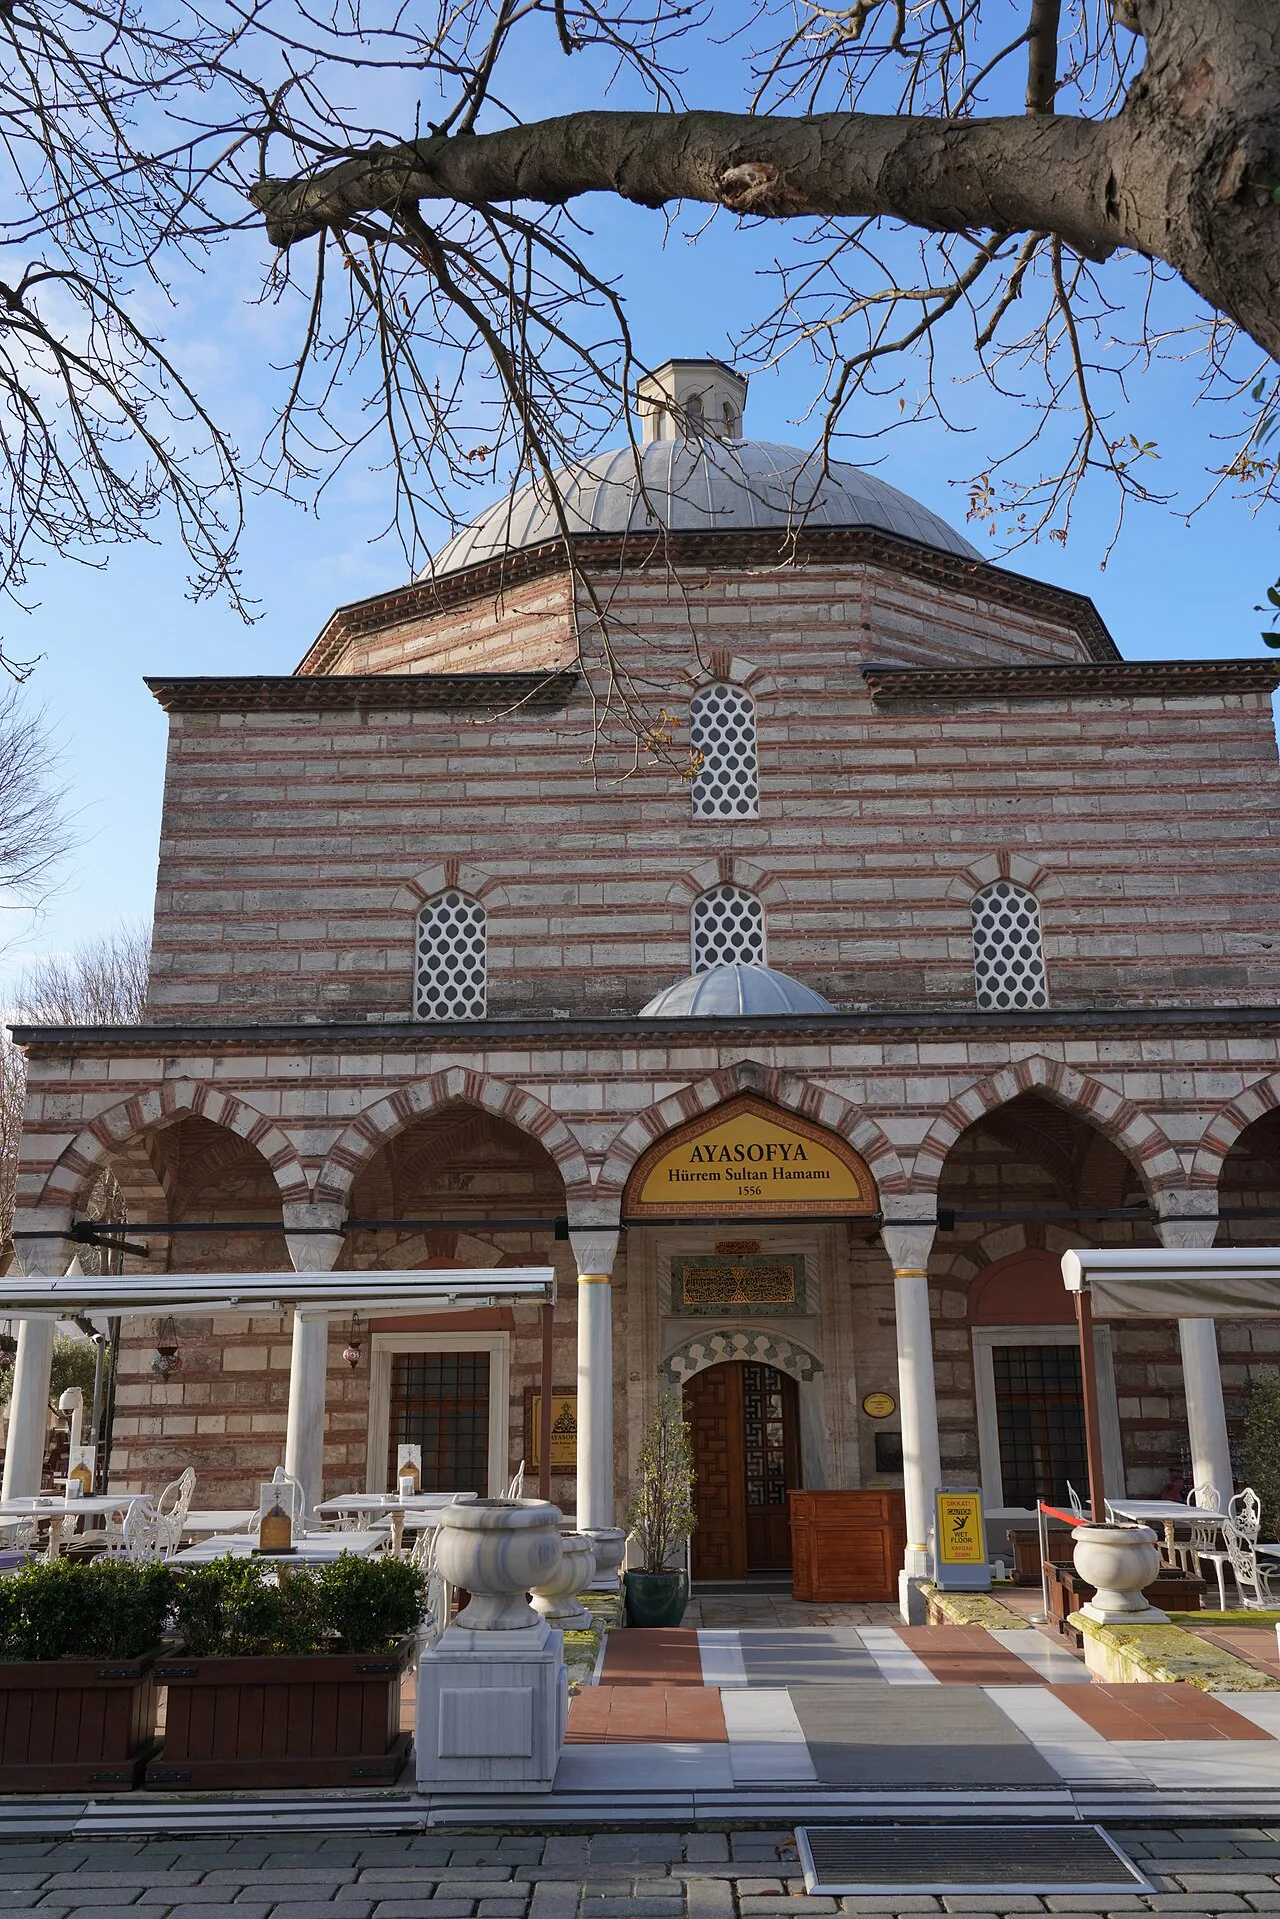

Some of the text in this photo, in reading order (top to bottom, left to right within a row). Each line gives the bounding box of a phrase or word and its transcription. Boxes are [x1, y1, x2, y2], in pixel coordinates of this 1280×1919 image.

[689, 1143, 808, 1163] AYASOFYA
[668, 1166, 830, 1182] Hürrem Sultan Hamamı
[738, 1186, 762, 1196] 1556
